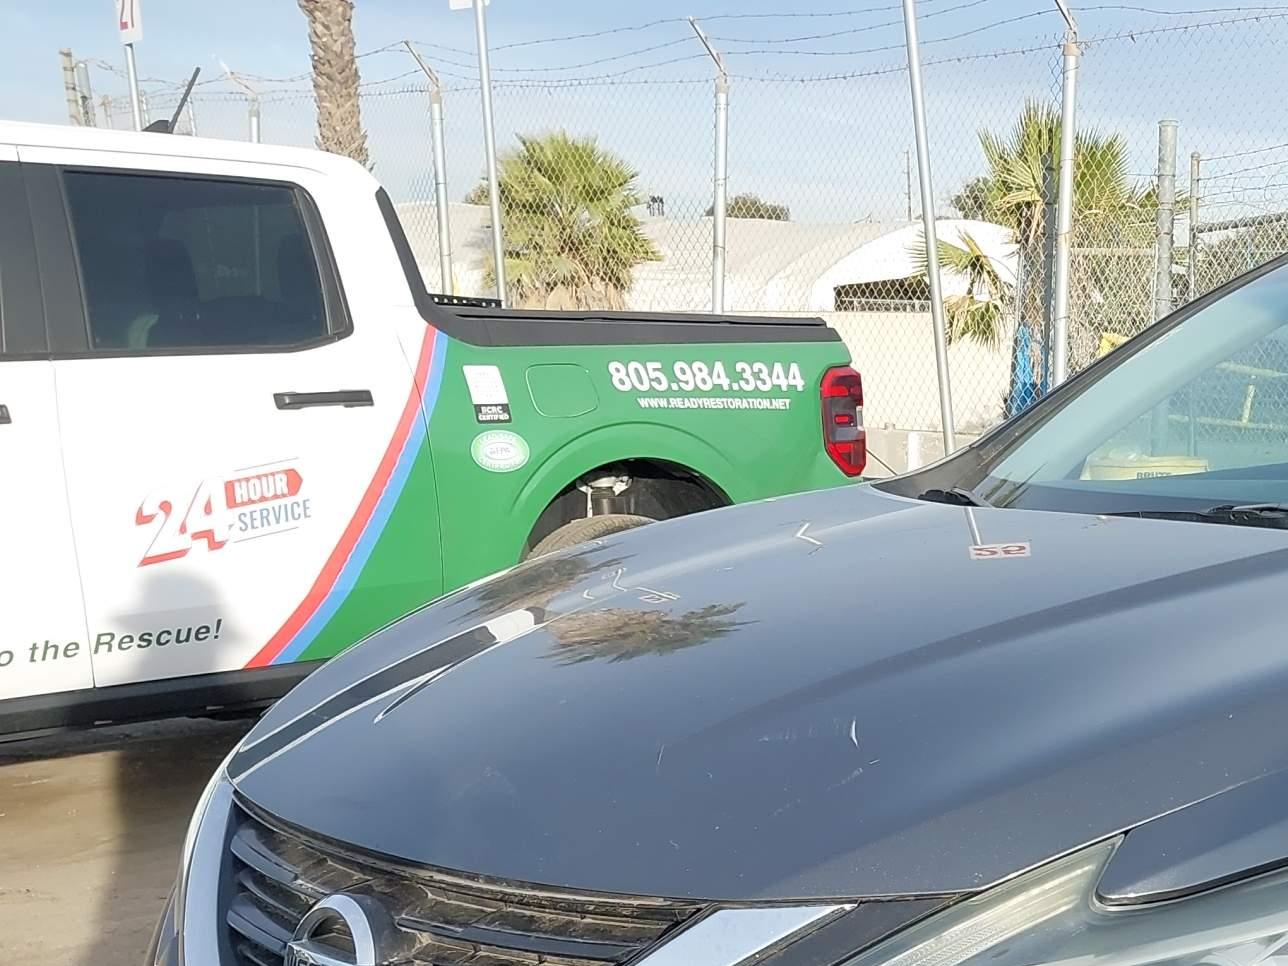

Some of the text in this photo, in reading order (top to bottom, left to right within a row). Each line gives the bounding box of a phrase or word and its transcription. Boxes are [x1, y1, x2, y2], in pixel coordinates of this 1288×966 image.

[607, 360, 805, 392] 805.984.3344
[636, 397, 792, 410] WWW.READYRESTORATION.NET
[232, 472, 289, 504] HOUR
[134, 478, 231, 568] 24
[237, 498, 312, 533] SERVICE
[0, 618, 223, 667] o the Rescue!
